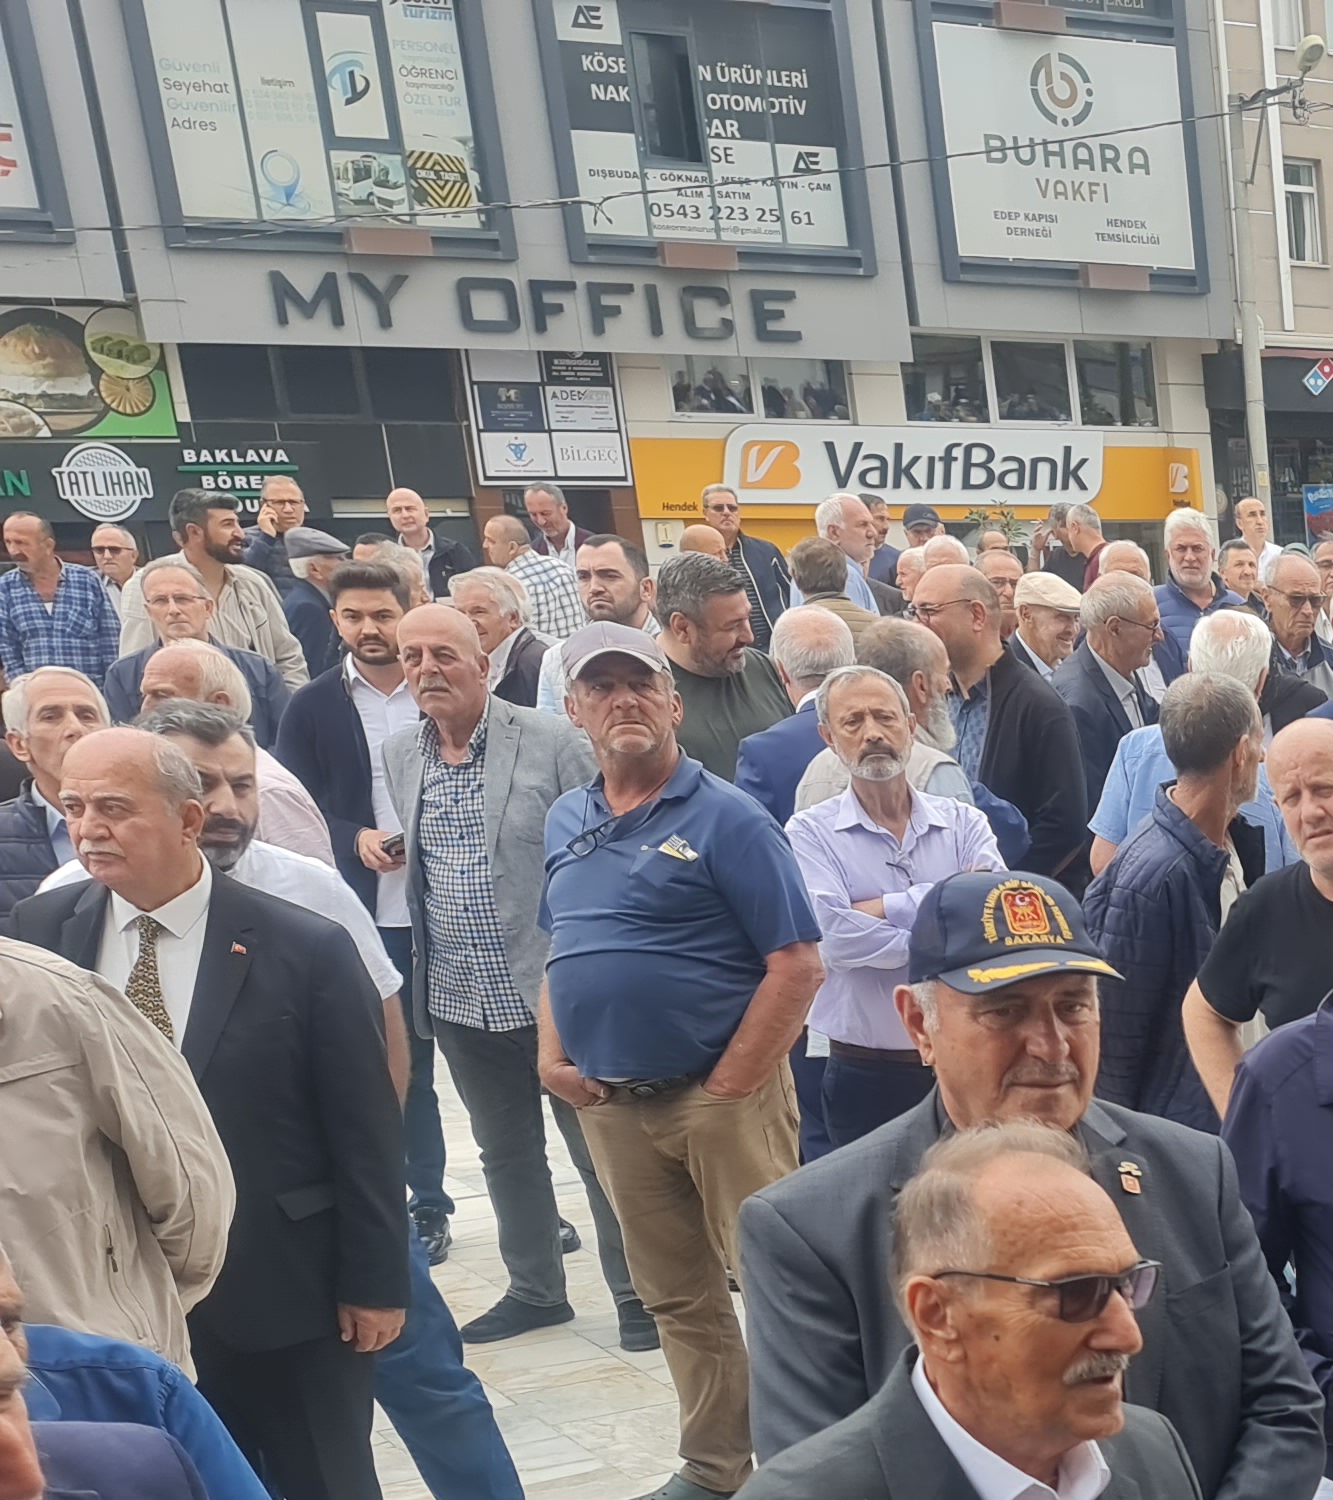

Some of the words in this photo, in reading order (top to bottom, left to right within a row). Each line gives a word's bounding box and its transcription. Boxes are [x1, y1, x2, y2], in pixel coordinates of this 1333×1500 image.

[402, 4, 453, 20] turizm
[392, 39, 457, 54] PERSONEL
[159, 58, 220, 75] Güvenli
[399, 64, 458, 80] ÖĞRENCİ
[716, 62, 808, 88] ÜRÜNLERİ
[162, 77, 230, 95] Seyehat
[403, 91, 434, 105] ÖZEL
[438, 96, 462, 107] TUR
[706, 93, 806, 116] OTOMOTİV
[171, 117, 217, 132] Adres
[983, 133, 1151, 176] BUHARA
[660, 171, 708, 184] GÖKNAR
[808, 181, 832, 192] ÇAM
[717, 190, 751, 201] SATIM
[1035, 178, 1109, 203] VAKFI
[650, 202, 701, 220] 0543
[709, 205, 749, 222] 223
[756, 207, 781, 223] 25
[791, 210, 815, 226] 61
[993, 210, 1021, 221] EDEP
[1024, 212, 1058, 224] KAPISI
[1006, 226, 1053, 238] DERNEĞİ
[1106, 218, 1147, 230] HENDEK
[1095, 232, 1160, 245] TEMSİLCİLİĞİ
[268, 269, 409, 328] MY
[456, 276, 803, 342] OFFICE
[182, 449, 289, 463] BAKLAVA
[823, 441, 1089, 493] VakıfBank
[55, 470, 151, 497] TATLIHAN
[201, 471, 268, 489] BÖRE
[662, 502, 698, 513] Hendek
[1004, 934, 1066, 946] SAKARYA
